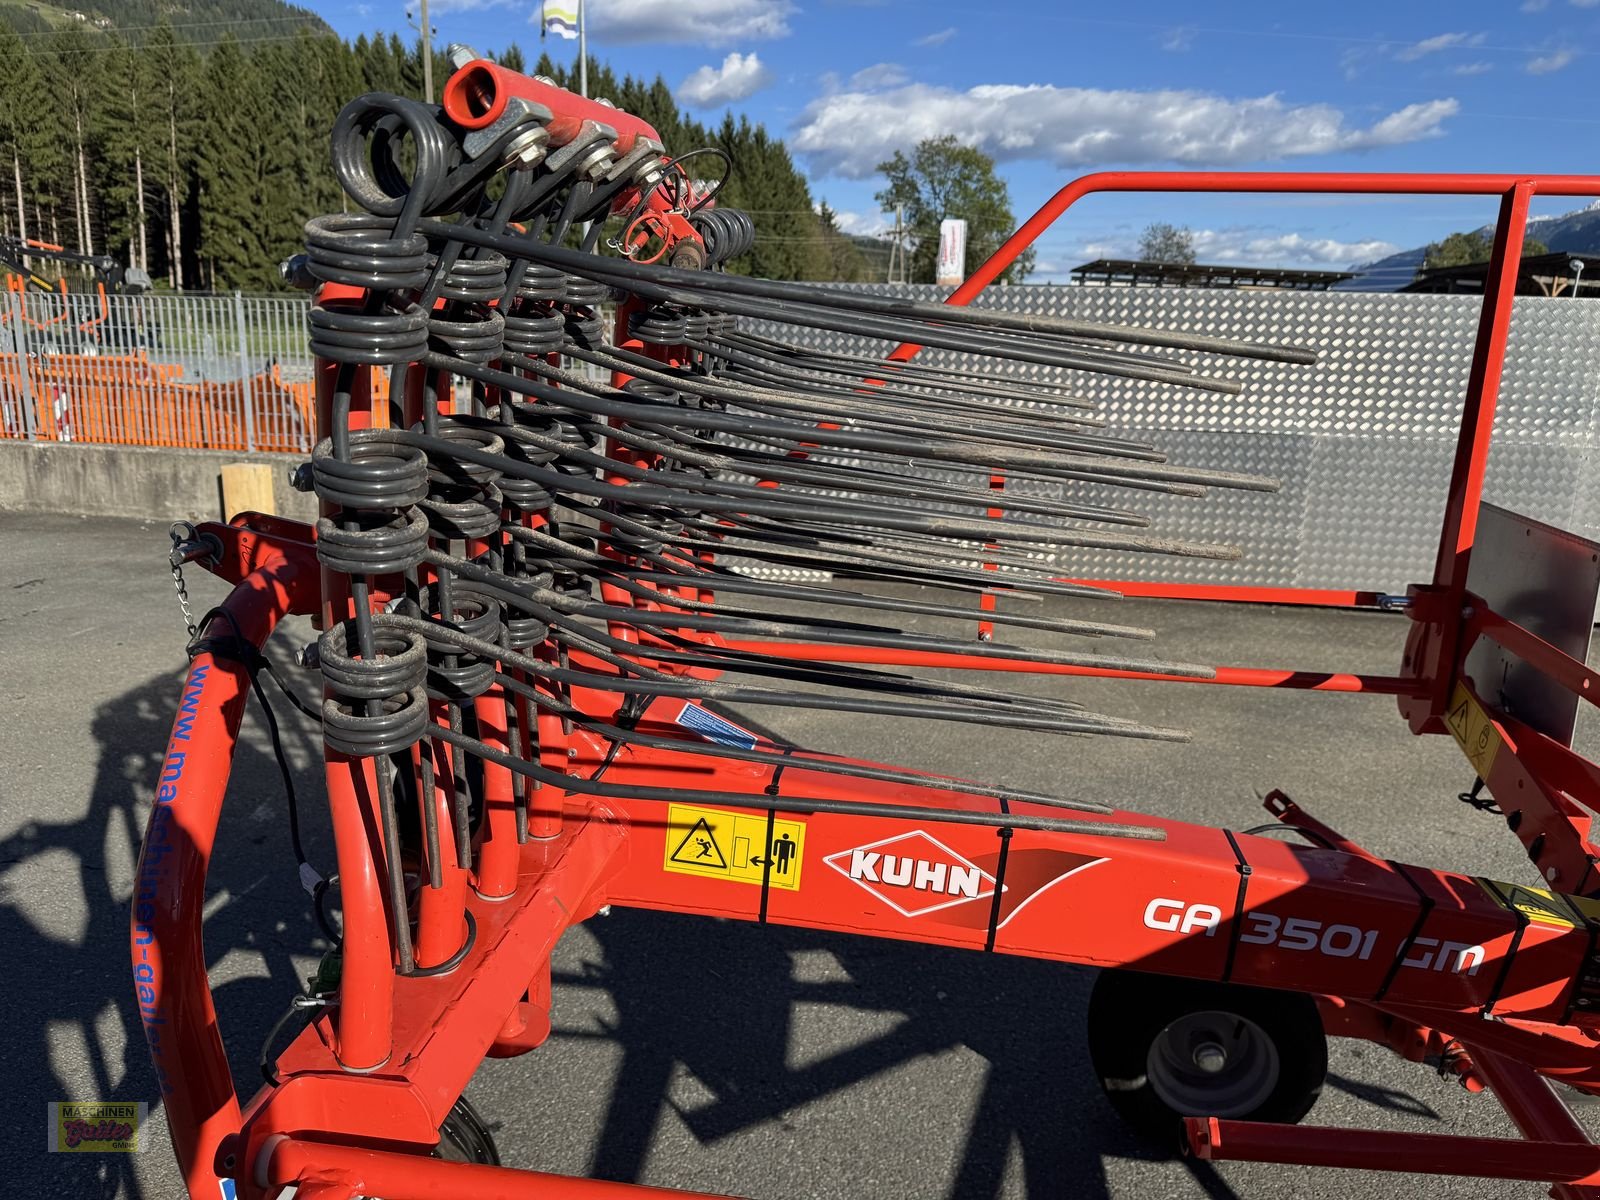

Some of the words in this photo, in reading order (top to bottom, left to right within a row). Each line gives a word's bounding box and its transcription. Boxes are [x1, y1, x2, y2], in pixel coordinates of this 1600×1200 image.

[849, 849, 981, 898] KUHN
[1143, 897, 1222, 937] GA
[1239, 911, 1379, 960] 3501
[1396, 935, 1485, 977] GM
